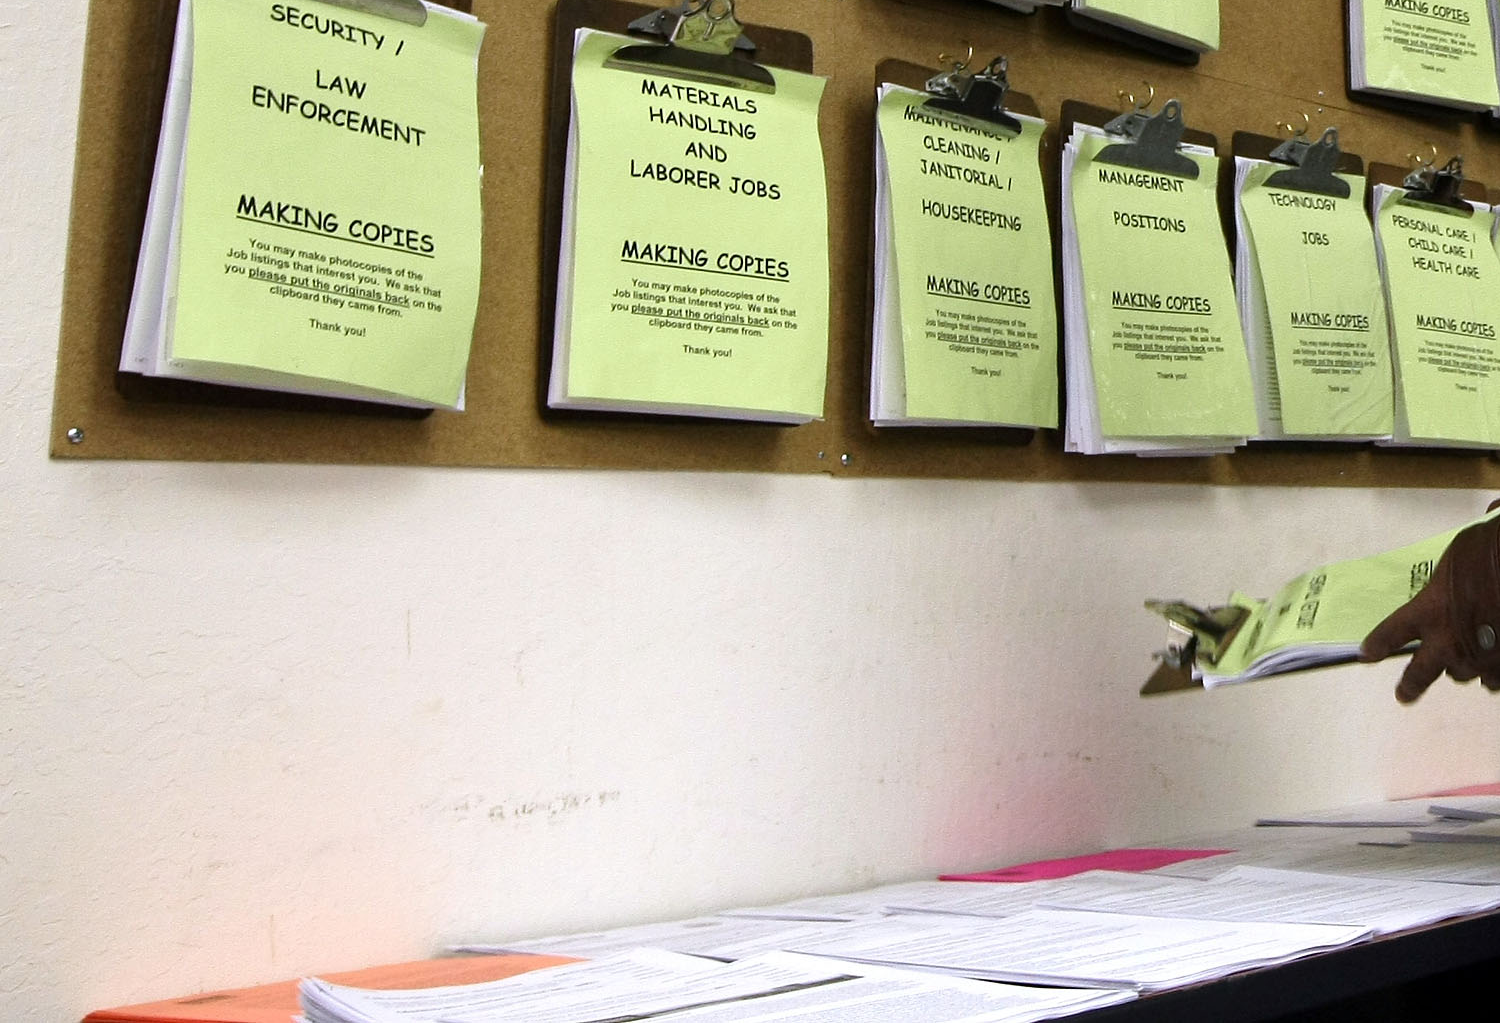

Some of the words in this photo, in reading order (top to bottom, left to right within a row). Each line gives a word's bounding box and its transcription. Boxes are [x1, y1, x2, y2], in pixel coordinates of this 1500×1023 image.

[271, 4, 384, 49] SECURITY
[1432, 5, 1470, 23] COPIES
[316, 70, 366, 99] LAW
[642, 79, 757, 114] MATERIALS
[252, 86, 425, 146] ENFORCEMENT
[649, 106, 756, 140] HANDLING
[685, 142, 727, 163] AND
[923, 135, 990, 162] CLEANING
[631, 159, 720, 190] LABORER
[729, 177, 780, 200] JOBS
[921, 159, 1003, 189] JANITORIAL
[1099, 169, 1183, 192] MANAGEMENT
[922, 199, 1021, 231] HOUSEKEEPING
[1268, 193, 1336, 211] TECHNOLOGY
[237, 195, 338, 233] MAKING
[349, 220, 434, 253] COPIES
[1114, 211, 1186, 233] POSITIONS
[1392, 215, 1443, 236] PERSONAL
[1446, 227, 1470, 242] CARE
[1302, 231, 1329, 246] JOBS
[1408, 237, 1439, 253] CHILD
[1442, 244, 1467, 258] CARE
[249, 238, 271, 251] You
[273, 246, 296, 258] may
[298, 250, 327, 262] make
[329, 256, 392, 279] photocopies
[395, 268, 406, 278] of
[407, 270, 423, 281] the
[622, 240, 708, 267] MAKING
[717, 253, 789, 278] COPIES
[1412, 257, 1453, 274] HEALTH
[1456, 264, 1480, 279] CARE
[227, 249, 248, 260] Job
[250, 252, 290, 270] listings
[293, 261, 313, 273] that
[316, 265, 355, 281] interest
[358, 275, 380, 286] you.
[385, 278, 401, 290] We
[403, 284, 421, 294] ask
[423, 286, 441, 298] that
[224, 264, 246, 274] you
[248, 268, 288, 286] please
[290, 276, 311, 290] put
[312, 278, 332, 292] the
[333, 284, 383, 304] originals
[384, 292, 411, 307] back
[412, 300, 425, 308] on
[427, 301, 442, 312] the
[269, 286, 320, 302] clipboard
[322, 295, 345, 309] they
[348, 301, 375, 312] came
[378, 304, 402, 317] from.
[632, 279, 649, 288] You
[651, 283, 671, 293] may
[673, 285, 697, 294] make
[699, 287, 754, 301] photocopies
[756, 293, 765, 302] of
[767, 294, 780, 304] the
[927, 275, 980, 297] MAKING
[983, 284, 1030, 305] COPIES
[612, 289, 631, 298] Job
[633, 291, 666, 304] listings
[668, 295, 686, 305] that
[688, 297, 722, 309] interest
[724, 303, 743, 312] you.
[747, 304, 761, 313] We
[763, 307, 778, 315] ask
[780, 308, 796, 317] that
[1112, 291, 1161, 309] MAKING
[1165, 296, 1211, 314] COPIES
[309, 318, 341, 332] Thank
[344, 326, 366, 337] you!
[611, 303, 629, 312] you
[631, 304, 665, 318] please
[666, 308, 684, 320] put
[685, 309, 702, 320] the
[703, 312, 746, 326] originals
[747, 316, 770, 327] back
[784, 320, 797, 330] the
[649, 319, 692, 330] clipboard
[694, 322, 713, 334] they
[715, 326, 739, 335] came
[741, 327, 763, 337] from.
[1291, 312, 1332, 328] MAKING
[1334, 314, 1369, 330] COPIES
[1417, 315, 1457, 332] MAKING
[1460, 321, 1495, 339] COPIES
[683, 345, 710, 355] Thank
[713, 349, 732, 358] you!
